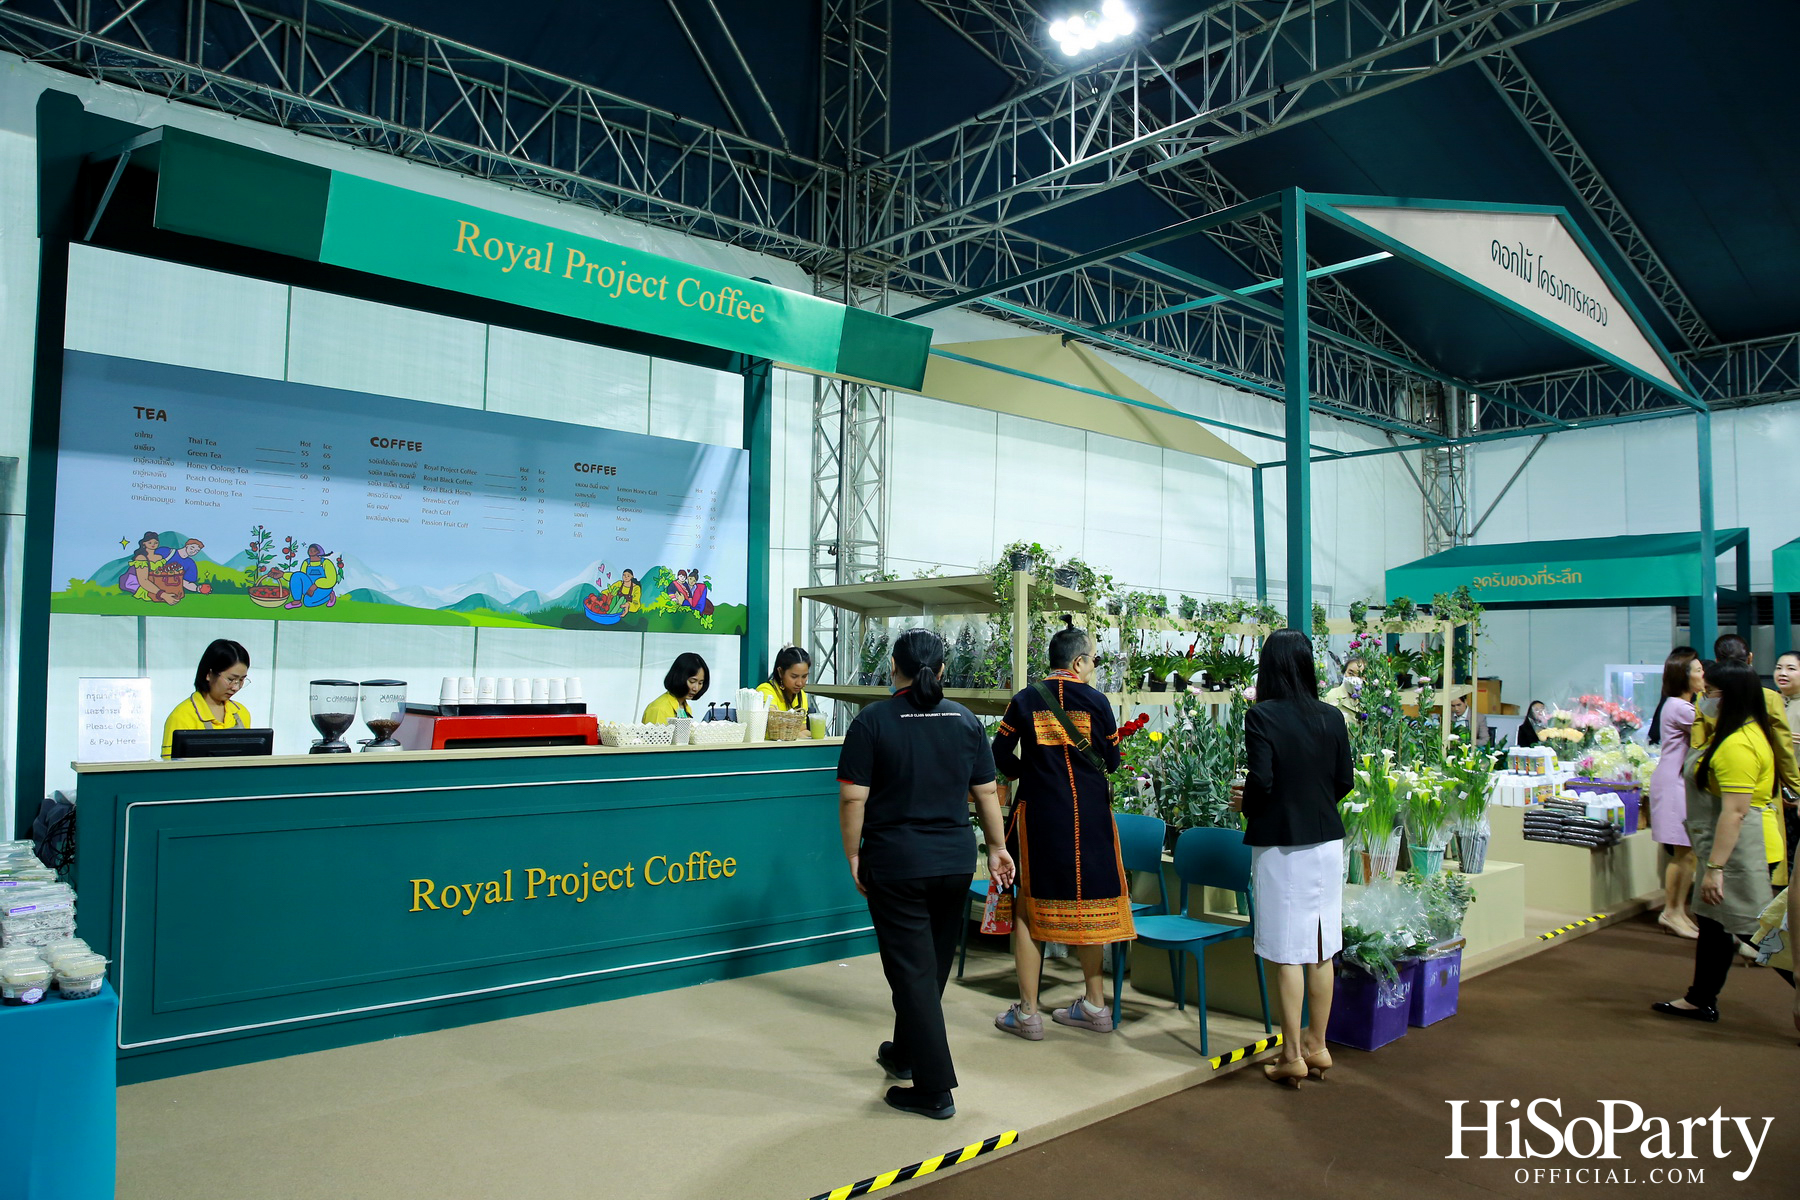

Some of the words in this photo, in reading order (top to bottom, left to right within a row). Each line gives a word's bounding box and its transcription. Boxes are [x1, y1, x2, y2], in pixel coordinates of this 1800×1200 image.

[452, 219, 555, 275] Royal
[562, 247, 670, 299] Project
[676, 277, 765, 323] Coffee
[1491, 239, 1533, 283] ดอกไม้
[1537, 255, 1608, 327] โครงการหลวง
[133, 406, 167, 422] TEA
[188, 436, 203, 445] Thai
[205, 438, 217, 446] Tea
[370, 436, 423, 452] COFFEE
[187, 449, 208, 458] Green
[210, 451, 222, 459] Tea
[186, 461, 208, 470] Honey
[210, 464, 236, 474] Oolong
[237, 466, 249, 474] Tea
[440, 464, 459, 474] Project
[460, 468, 478, 476] Coffee
[574, 462, 617, 476] COFFEE
[186, 474, 206, 482] Peach
[208, 476, 233, 486] Oolong
[423, 475, 439, 483] Royal
[204, 488, 229, 498] Oolong
[184, 498, 221, 508] Kombucha
[616, 496, 637, 504] Espresso
[616, 506, 643, 514] Cappuccino
[89, 738, 97, 746] &
[98, 738, 114, 747] Pay
[409, 869, 514, 916] Royal
[524, 861, 635, 903] Project
[644, 850, 737, 887] Coffee
